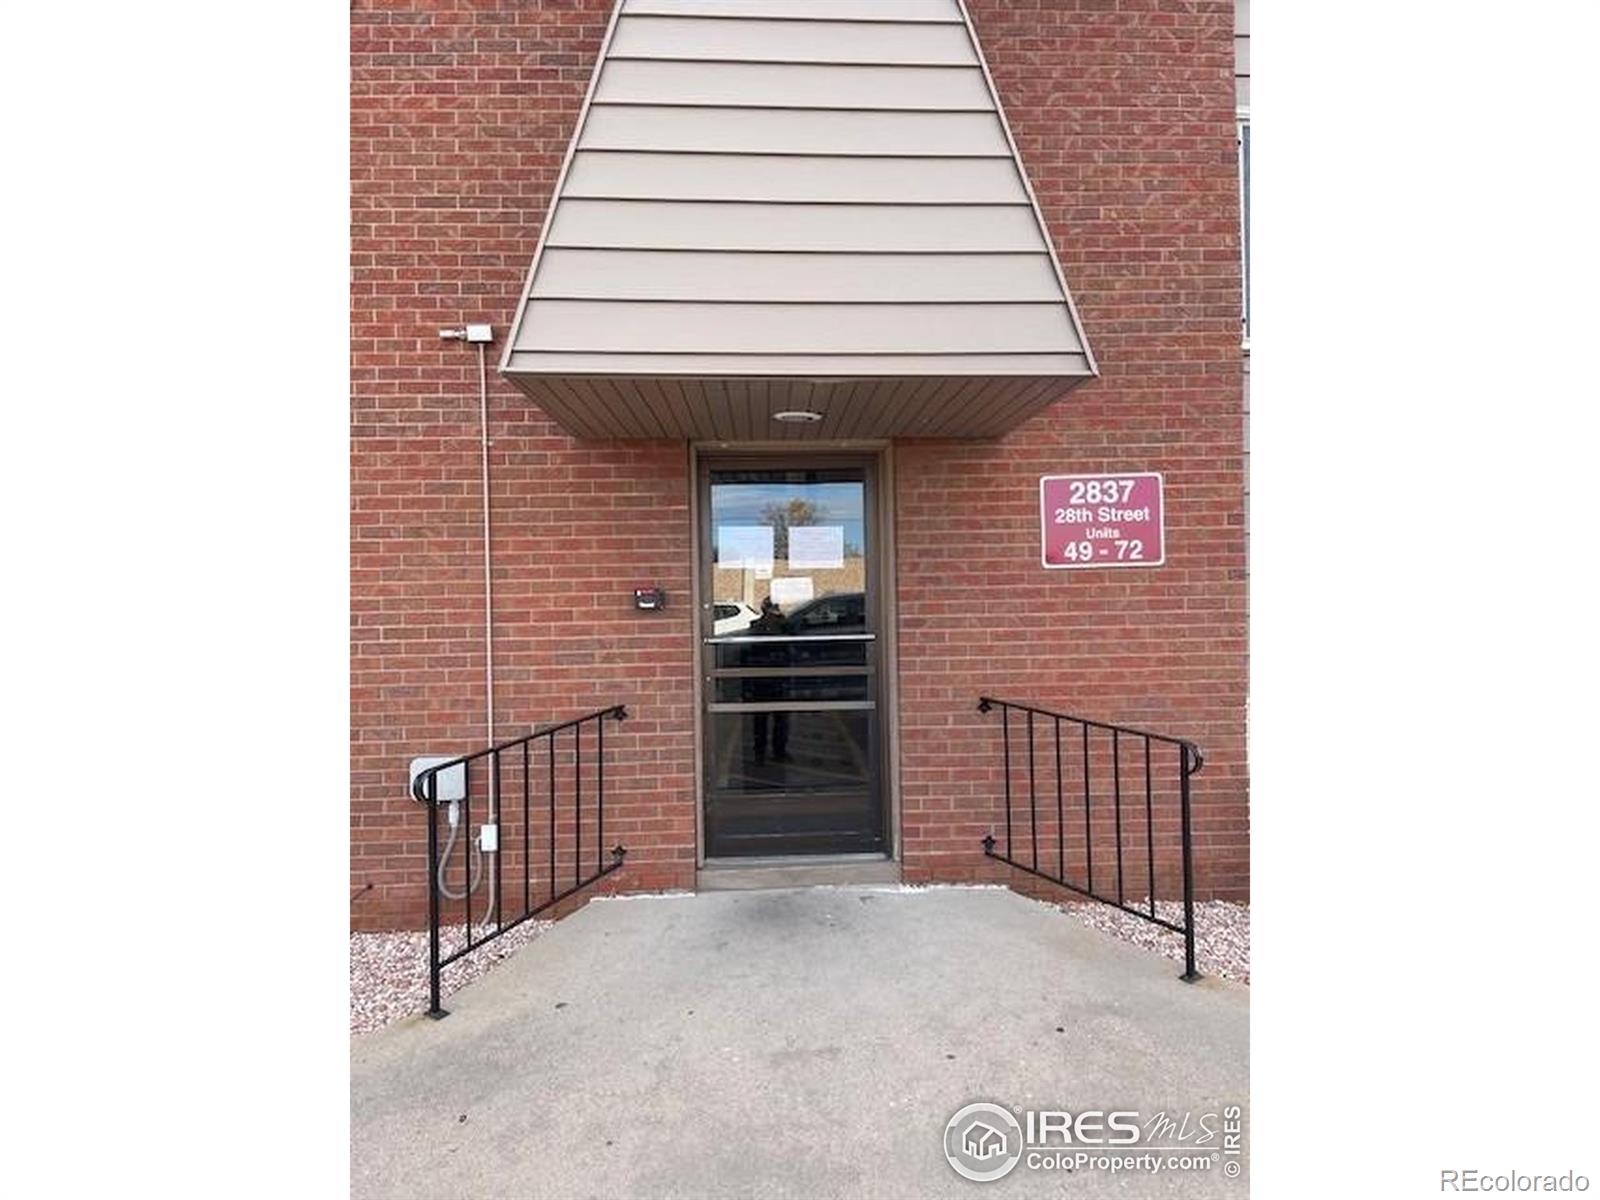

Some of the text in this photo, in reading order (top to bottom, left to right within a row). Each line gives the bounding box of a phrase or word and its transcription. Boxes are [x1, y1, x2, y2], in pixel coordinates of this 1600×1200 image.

[1069, 480, 1135, 504] 2837
[1055, 506, 1150, 523] 28th Street
[1085, 527, 1120, 539] Units
[1064, 541, 1093, 561] 49
[1114, 540, 1143, 560] 72
